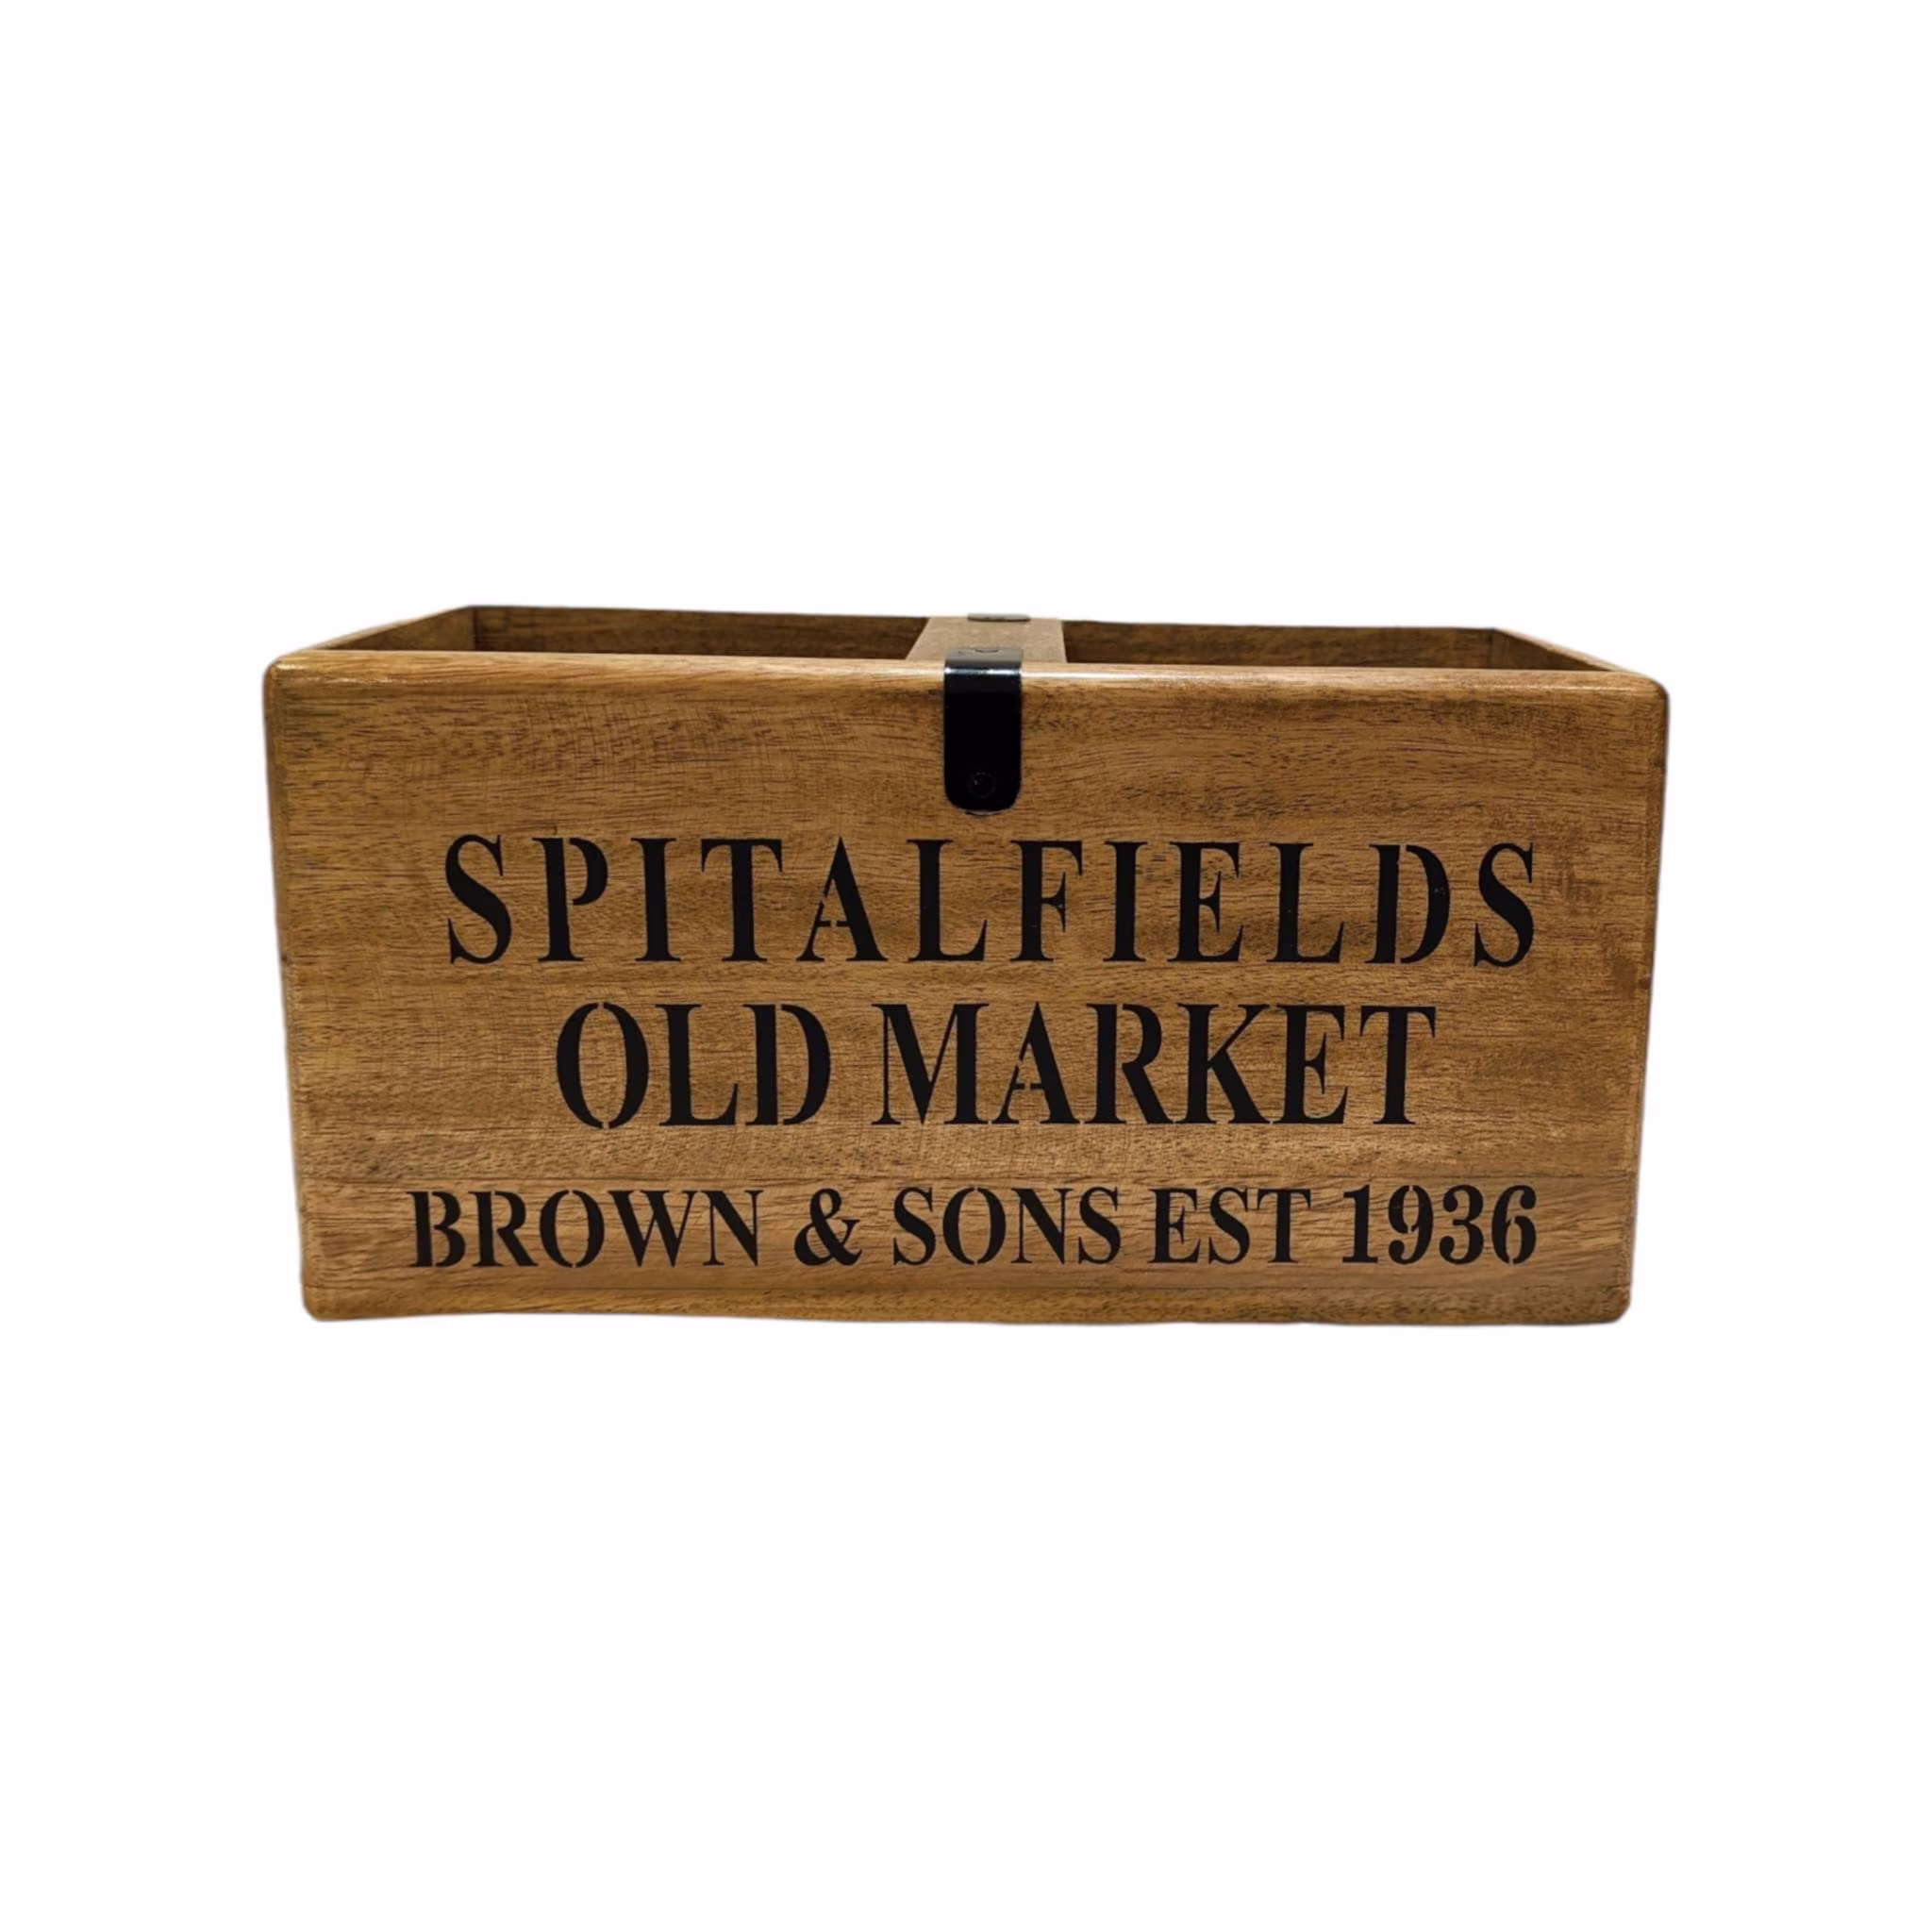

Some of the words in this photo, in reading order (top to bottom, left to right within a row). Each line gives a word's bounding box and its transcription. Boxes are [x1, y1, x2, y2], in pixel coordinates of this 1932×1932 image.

[444, 832, 1538, 968] SPITALFIELDS
[555, 1001, 832, 1131] OLD
[870, 1000, 1437, 1127] MARKET
[406, 1188, 764, 1270] BROWN
[792, 1187, 864, 1268] &
[891, 1186, 1123, 1266] SONS
[1148, 1186, 1312, 1265] EST
[1342, 1183, 1538, 1266] 1936
